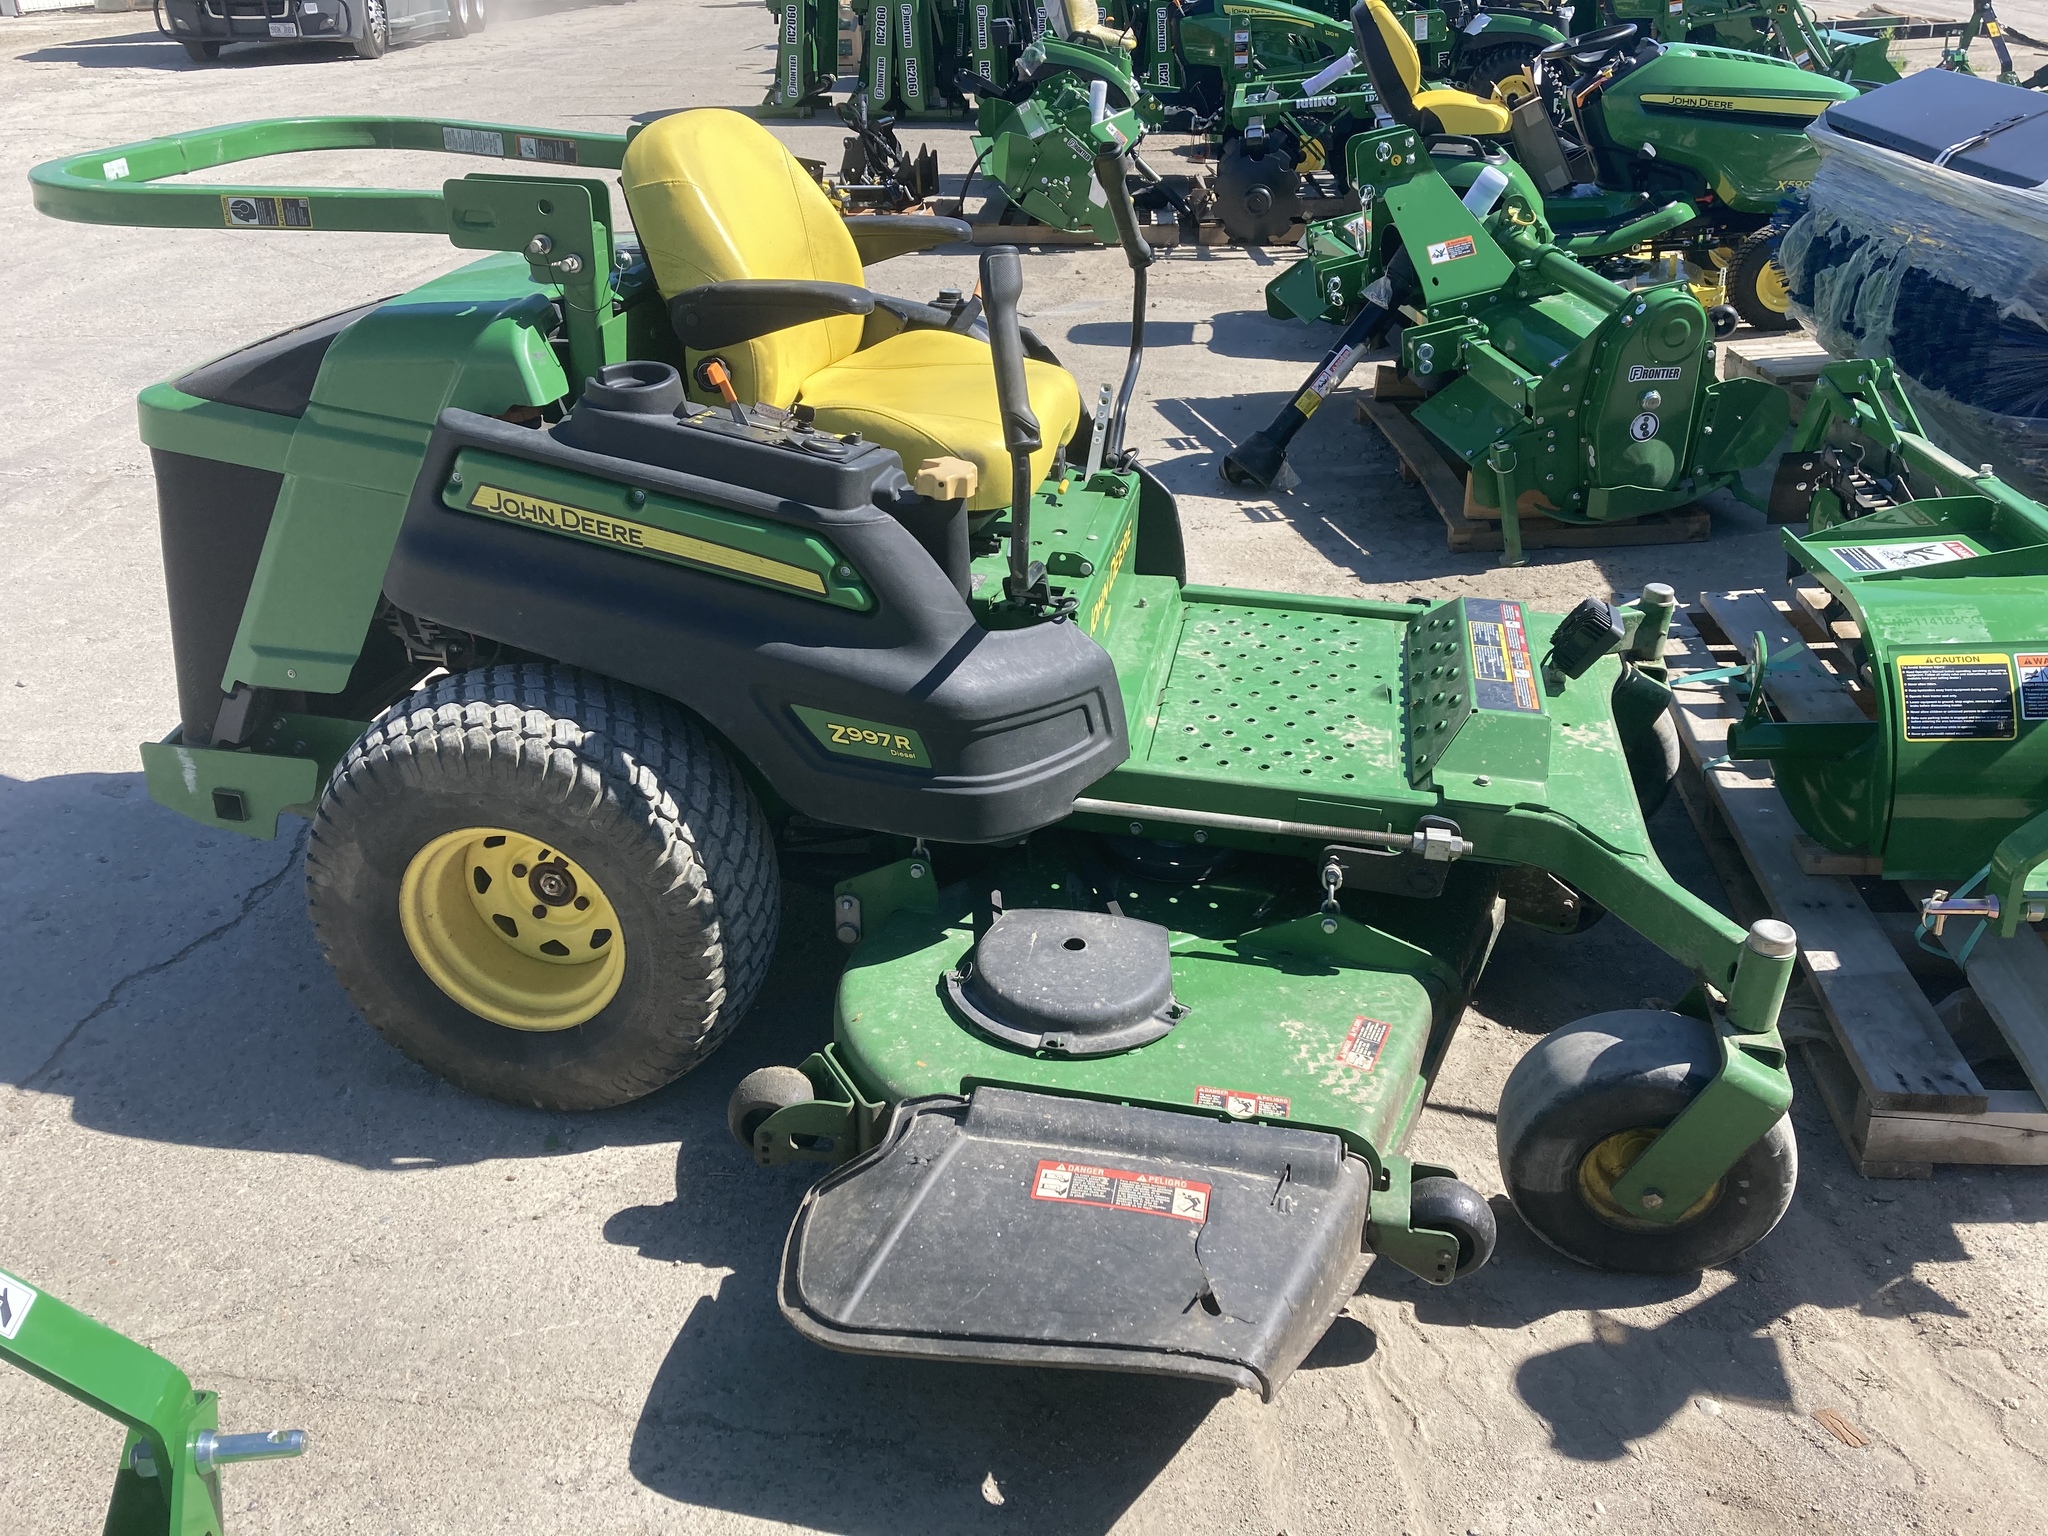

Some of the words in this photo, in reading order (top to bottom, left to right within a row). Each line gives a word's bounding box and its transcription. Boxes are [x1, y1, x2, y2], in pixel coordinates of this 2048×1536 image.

[786, 5, 797, 44] RC2060
[876, 6, 886, 46] RC2060
[901, 4, 912, 48] FRONTIER
[977, 5, 987, 49] FRONTIER
[1156, 8, 1167, 52] FRONTIER
[788, 55, 797, 97] FRONTIER
[875, 57, 885, 99] FRONTIER
[906, 58, 918, 97] RC2060
[980, 60, 991, 82] RC2
[1669, 95, 1698, 107] JOHN
[1699, 98, 1734, 110] DEERE
[1067, 138, 1092, 162] FRONTIER
[1628, 365, 1681, 382] FRONTIER
[490, 492, 555, 524] JOHN
[561, 508, 644, 546] DEERE
[1934, 655, 1981, 664] CAUTION
[890, 749, 916, 759] Diesel
[1068, 1164, 1105, 1176] DANGER
[1148, 1175, 1187, 1189] PELIGRO
